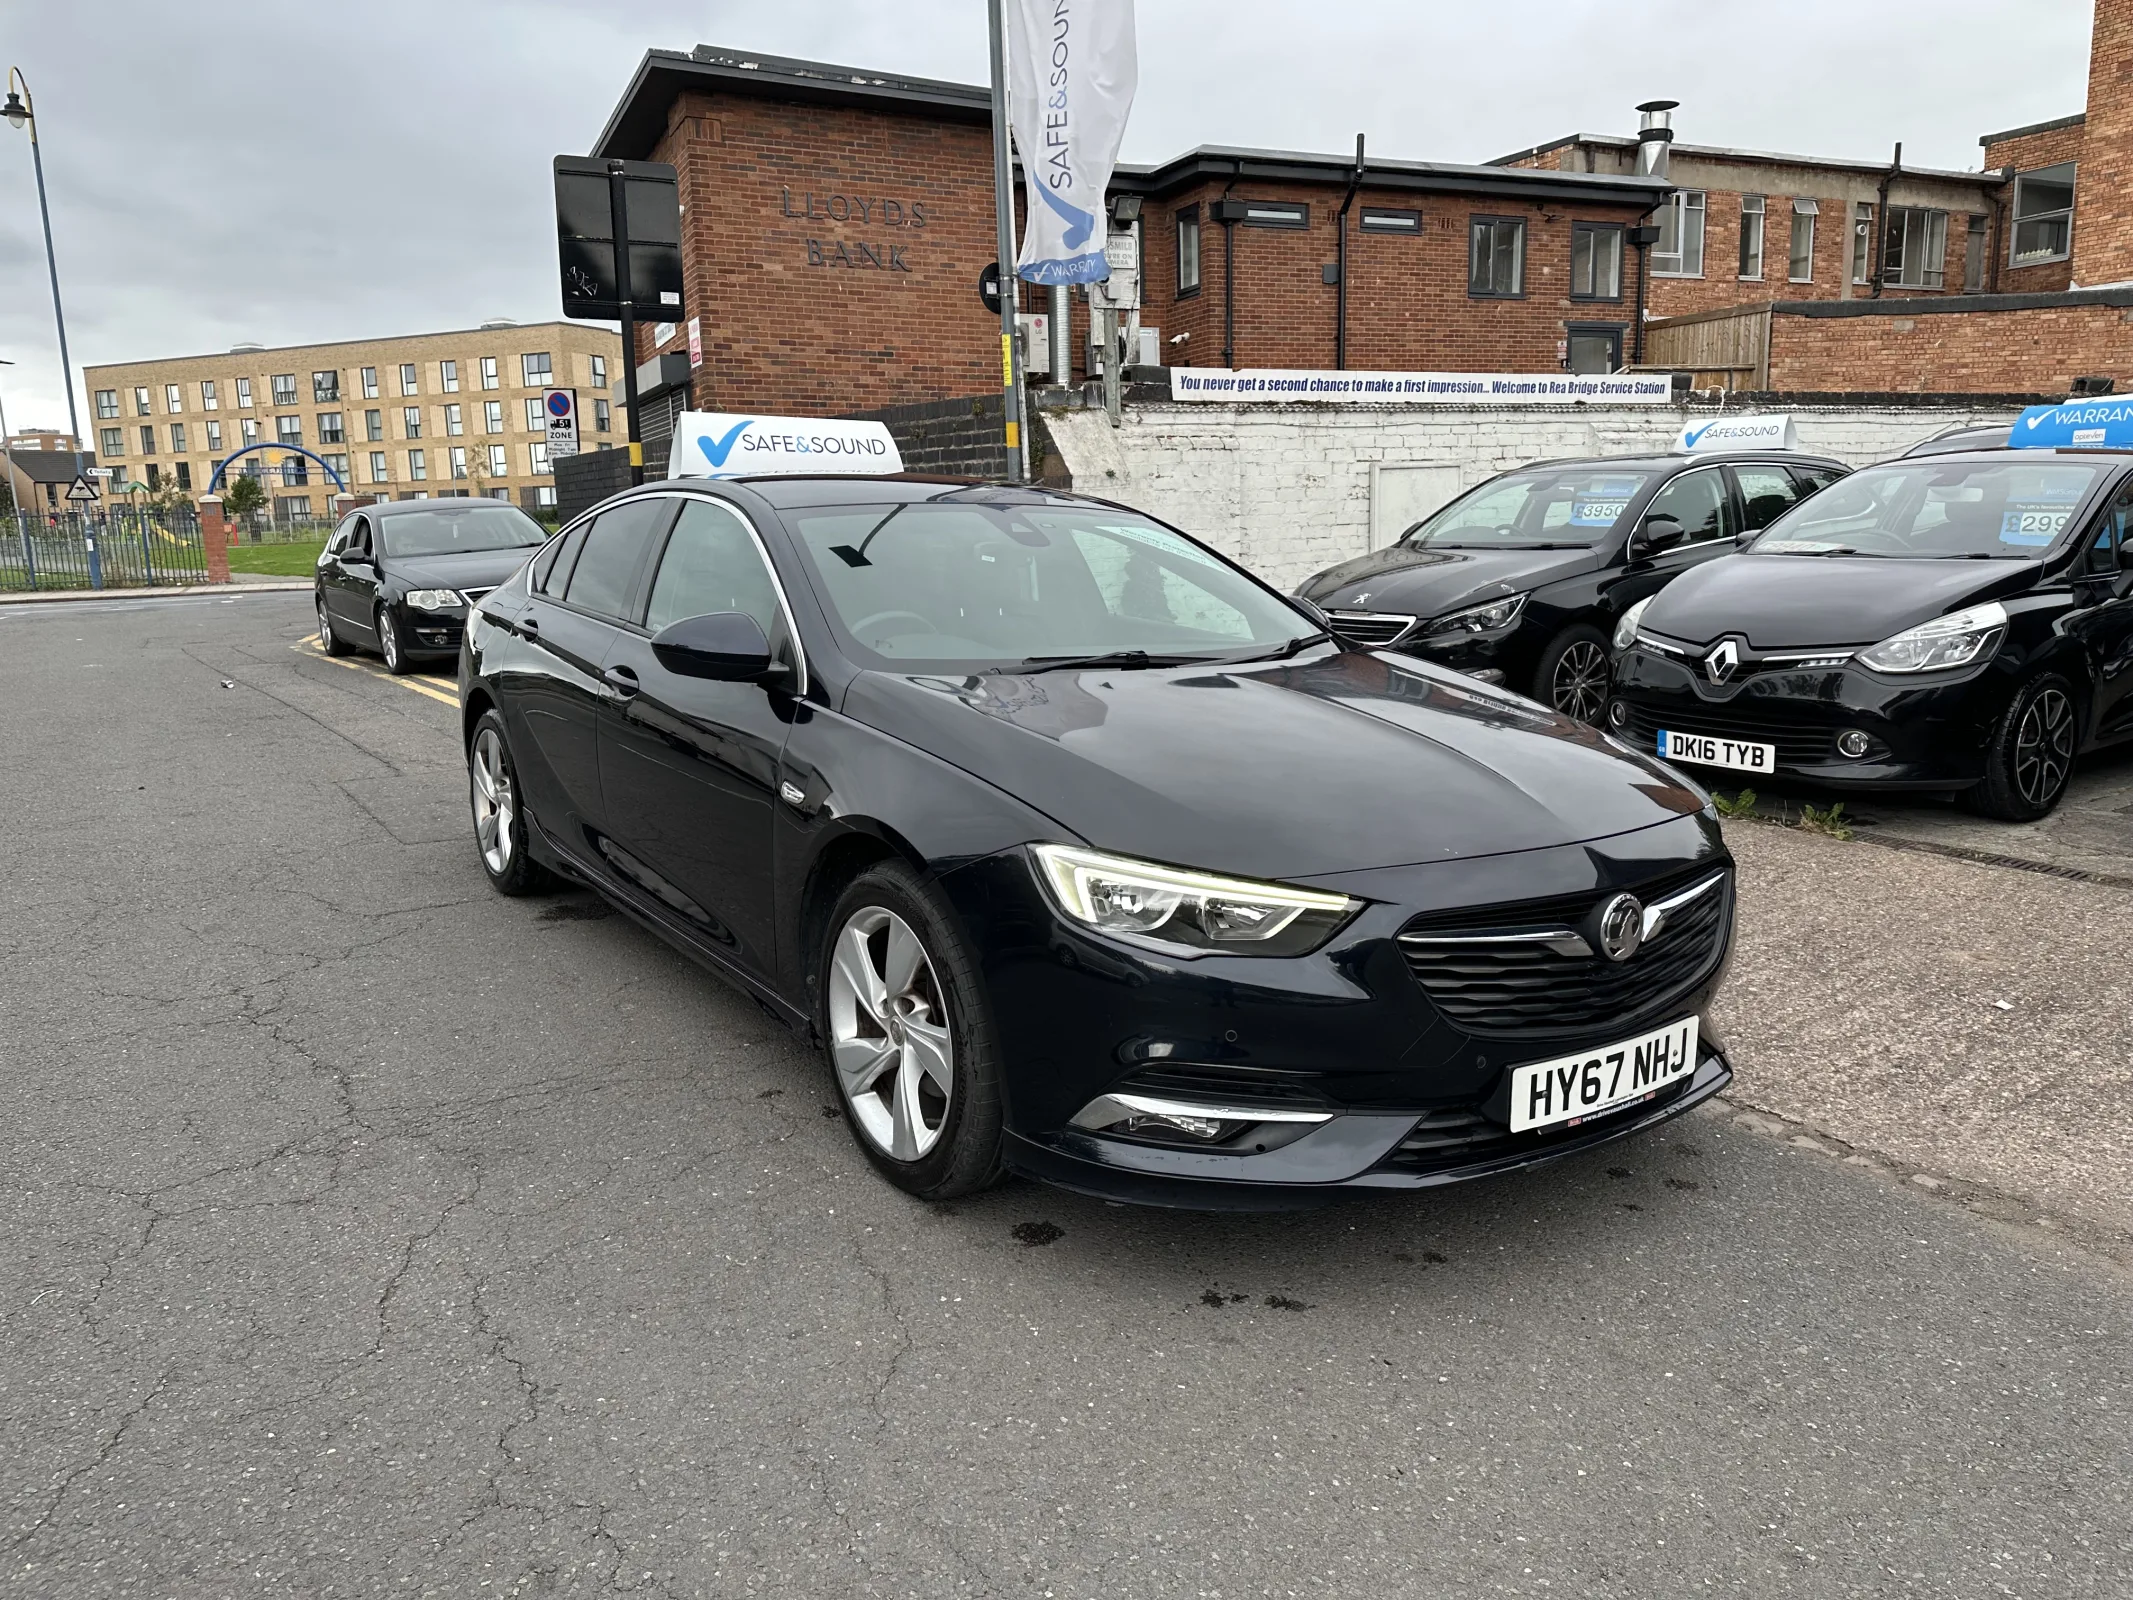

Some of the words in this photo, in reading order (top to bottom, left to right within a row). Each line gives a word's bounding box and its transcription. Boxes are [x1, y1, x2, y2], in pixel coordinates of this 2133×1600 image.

[783, 188, 926, 227] LLOYDS
[806, 238, 913, 272] BANK
[1180, 375, 1200, 390] You
[1203, 378, 1236, 391] never
[1238, 377, 1256, 392] get
[1258, 379, 1265, 391] a
[1267, 377, 1309, 392] second
[1310, 378, 1350, 392] chance
[1352, 380, 1364, 392] to
[1365, 378, 1394, 392] make
[1395, 381, 1402, 393] a
[1404, 379, 1426, 393] first
[1492, 380, 1536, 394] Welcome
[1538, 382, 1548, 394] to
[1549, 381, 1567, 394] Rea
[1568, 381, 1599, 396] Bridge
[1600, 381, 1633, 395] Service
[1634, 381, 1666, 395] Station
[550, 431, 573, 439] ZONE
[742, 433, 886, 455] SAFE&SOUND
[1704, 425, 1780, 439] SAFE&SOUND
[1672, 734, 1716, 761] DK16
[1722, 742, 1765, 767] TYB
[1528, 1051, 1625, 1121] HY67
[1633, 1027, 1688, 1090] NHJ
